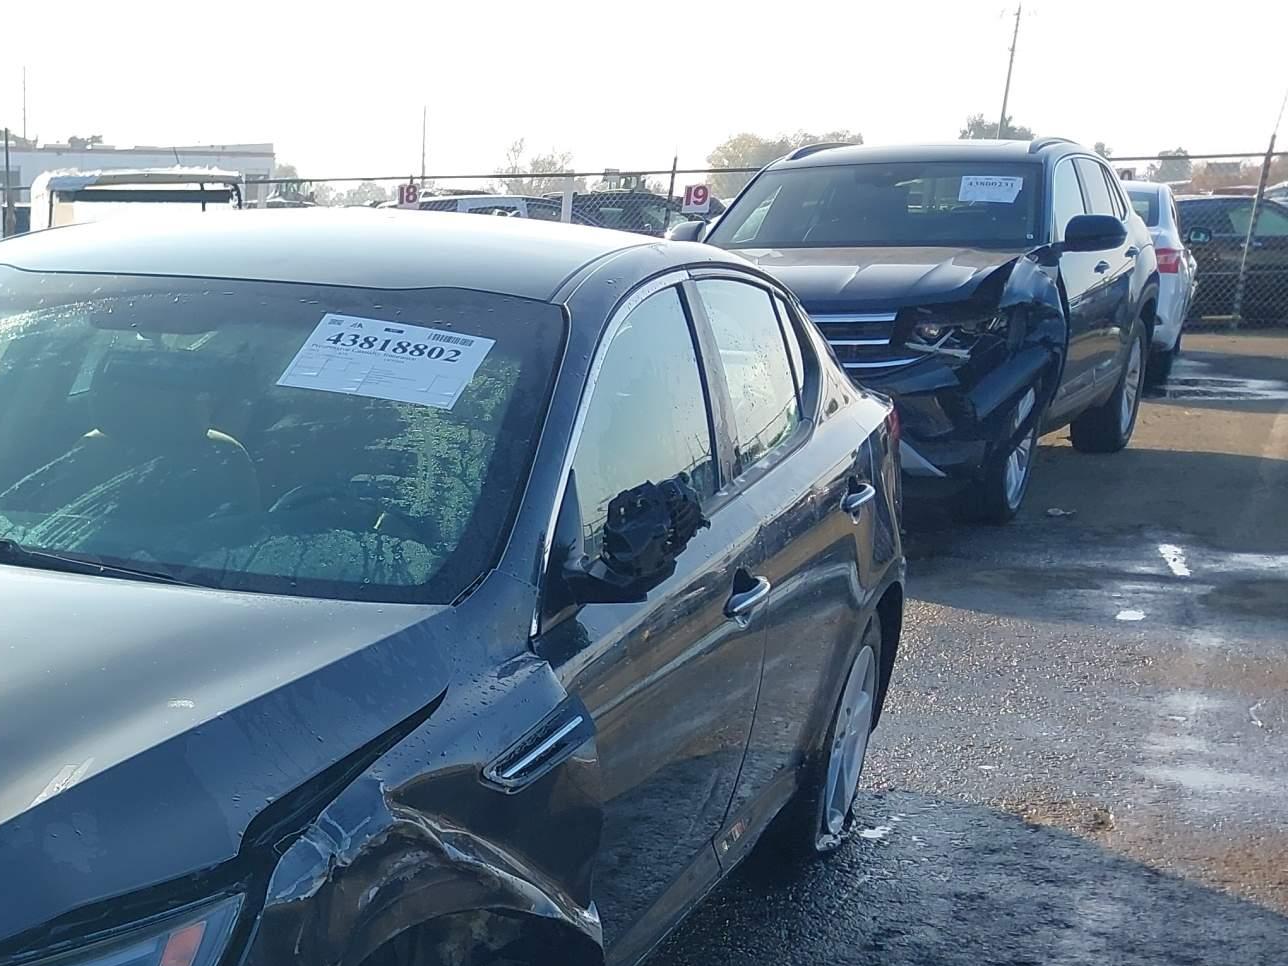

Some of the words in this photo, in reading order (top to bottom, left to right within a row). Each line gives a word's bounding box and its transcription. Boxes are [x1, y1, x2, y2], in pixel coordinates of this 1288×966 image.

[399, 184, 418, 205] 18
[685, 183, 709, 206] 19
[326, 332, 462, 363] 43818802
